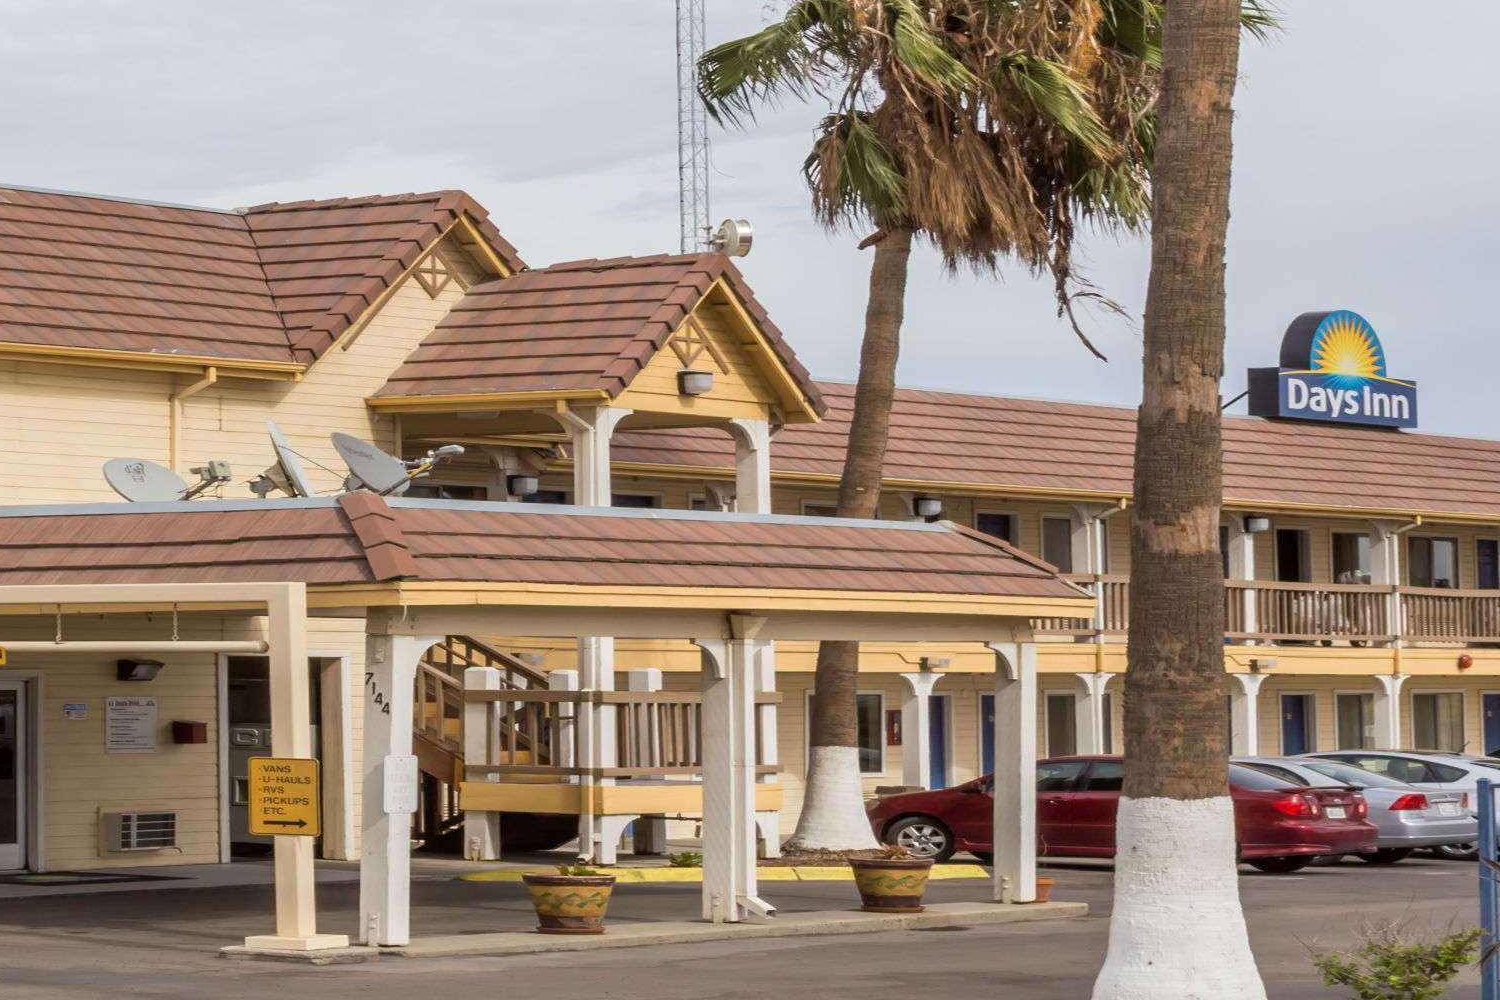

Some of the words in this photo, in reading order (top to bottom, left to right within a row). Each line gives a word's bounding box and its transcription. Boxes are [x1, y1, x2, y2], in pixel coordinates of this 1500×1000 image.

[1287, 377, 1358, 418] Days
[1363, 385, 1410, 419] Inn
[364, 672, 391, 715] 7144
